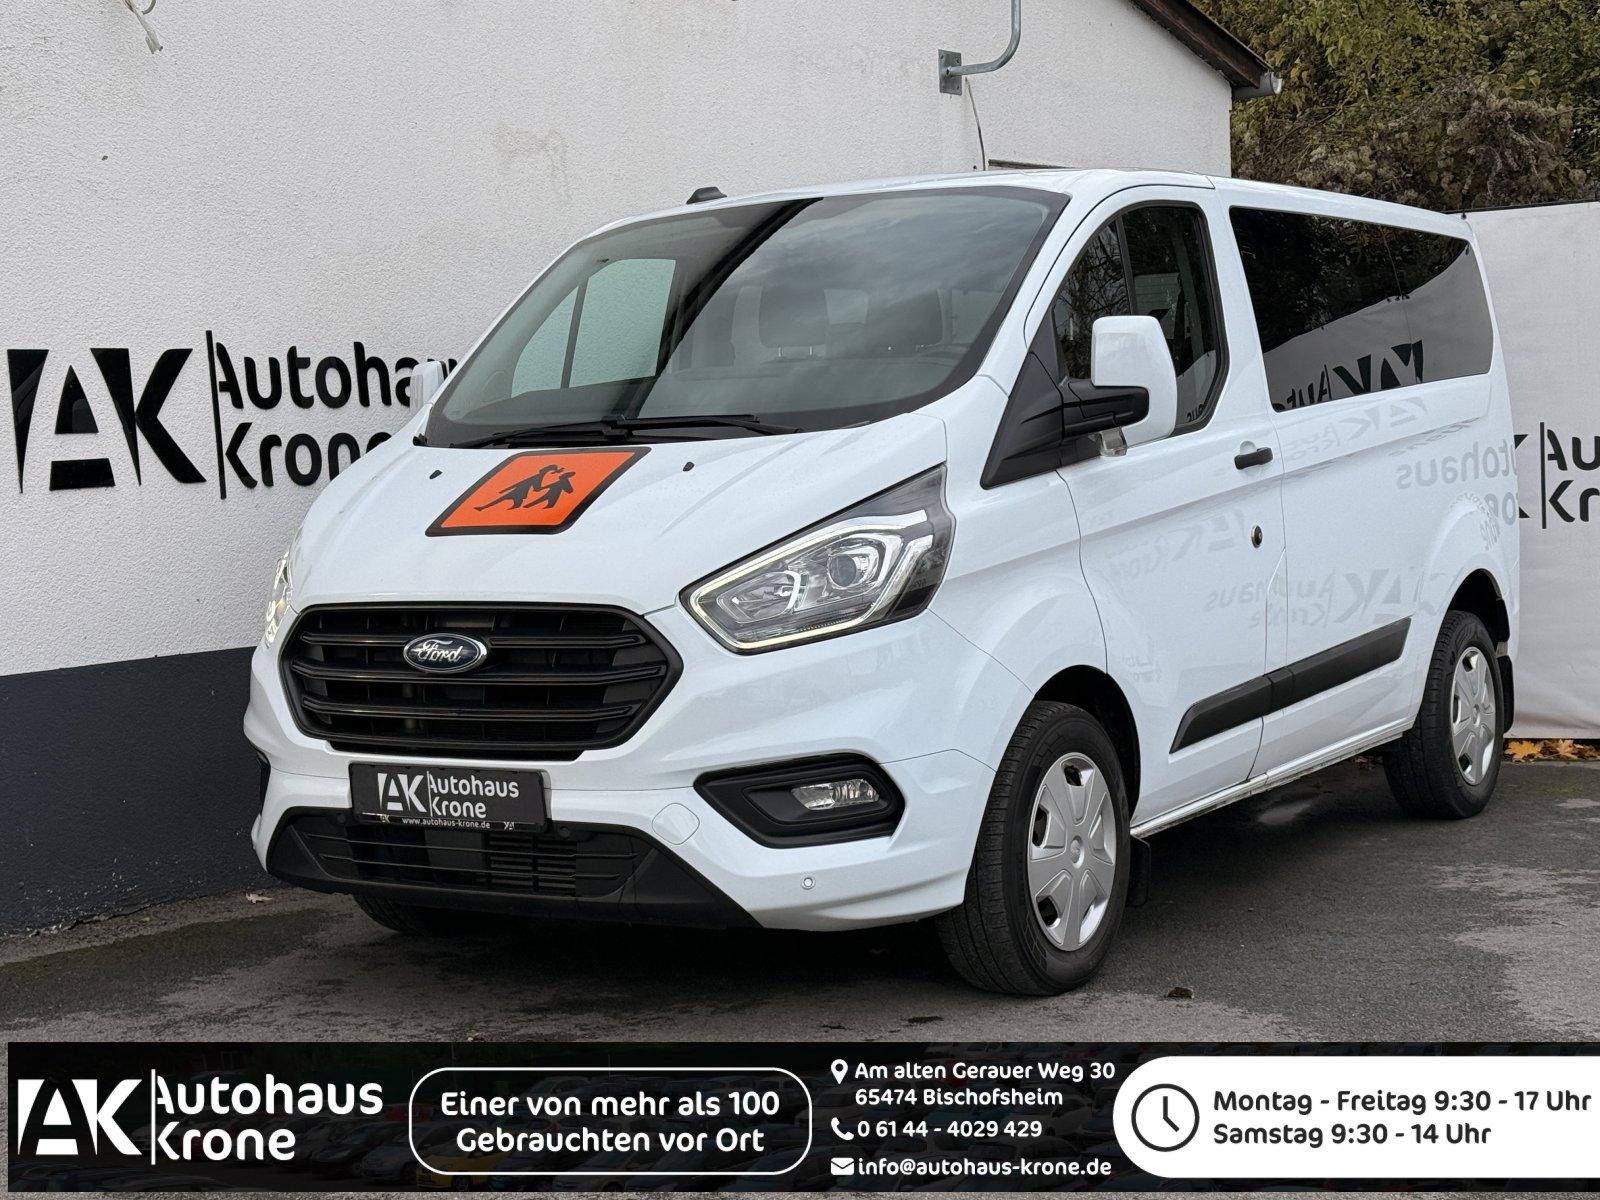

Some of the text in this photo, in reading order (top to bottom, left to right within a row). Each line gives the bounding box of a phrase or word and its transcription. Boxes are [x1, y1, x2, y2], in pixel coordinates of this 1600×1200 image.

[216, 341, 458, 410] Autoha
[7, 347, 207, 493] AK
[225, 421, 392, 488] Kron
[410, 639, 464, 662] Ford
[377, 772, 427, 813] AK
[430, 774, 520, 798] Autohaus
[402, 816, 491, 830] www.autohaus-krone.de
[432, 796, 487, 818] Krone
